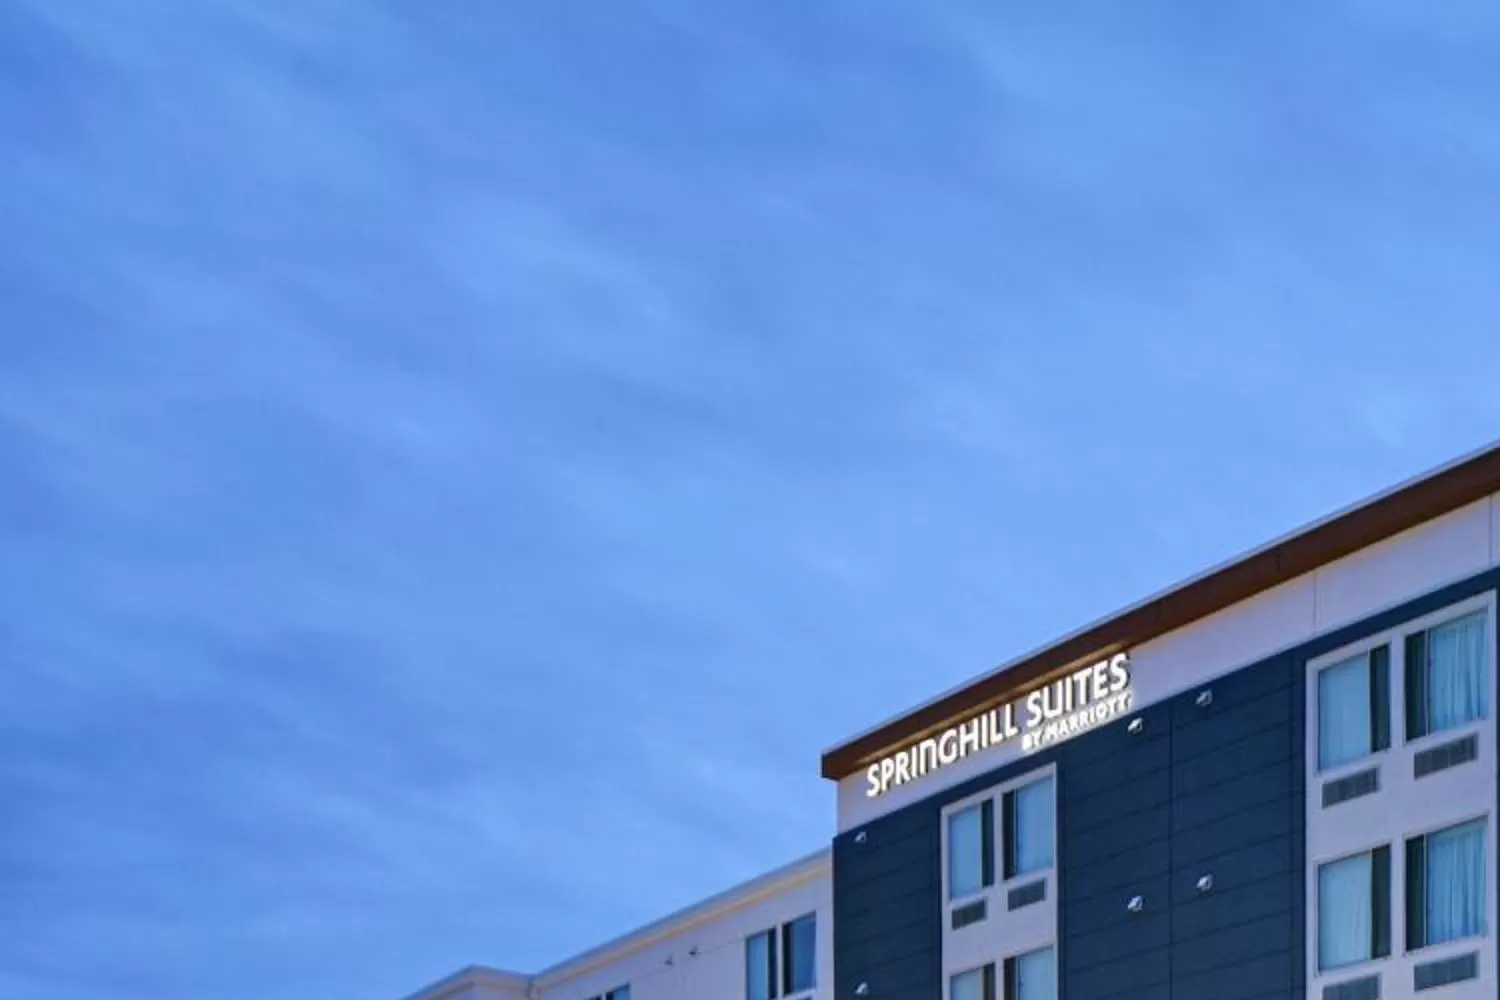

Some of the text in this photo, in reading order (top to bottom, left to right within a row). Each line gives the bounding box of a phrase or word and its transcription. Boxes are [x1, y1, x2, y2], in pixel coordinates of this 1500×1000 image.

[866, 653, 1130, 797] SPRINGHILL SUITES
[1022, 692, 1129, 750] BY MARRIOTT
